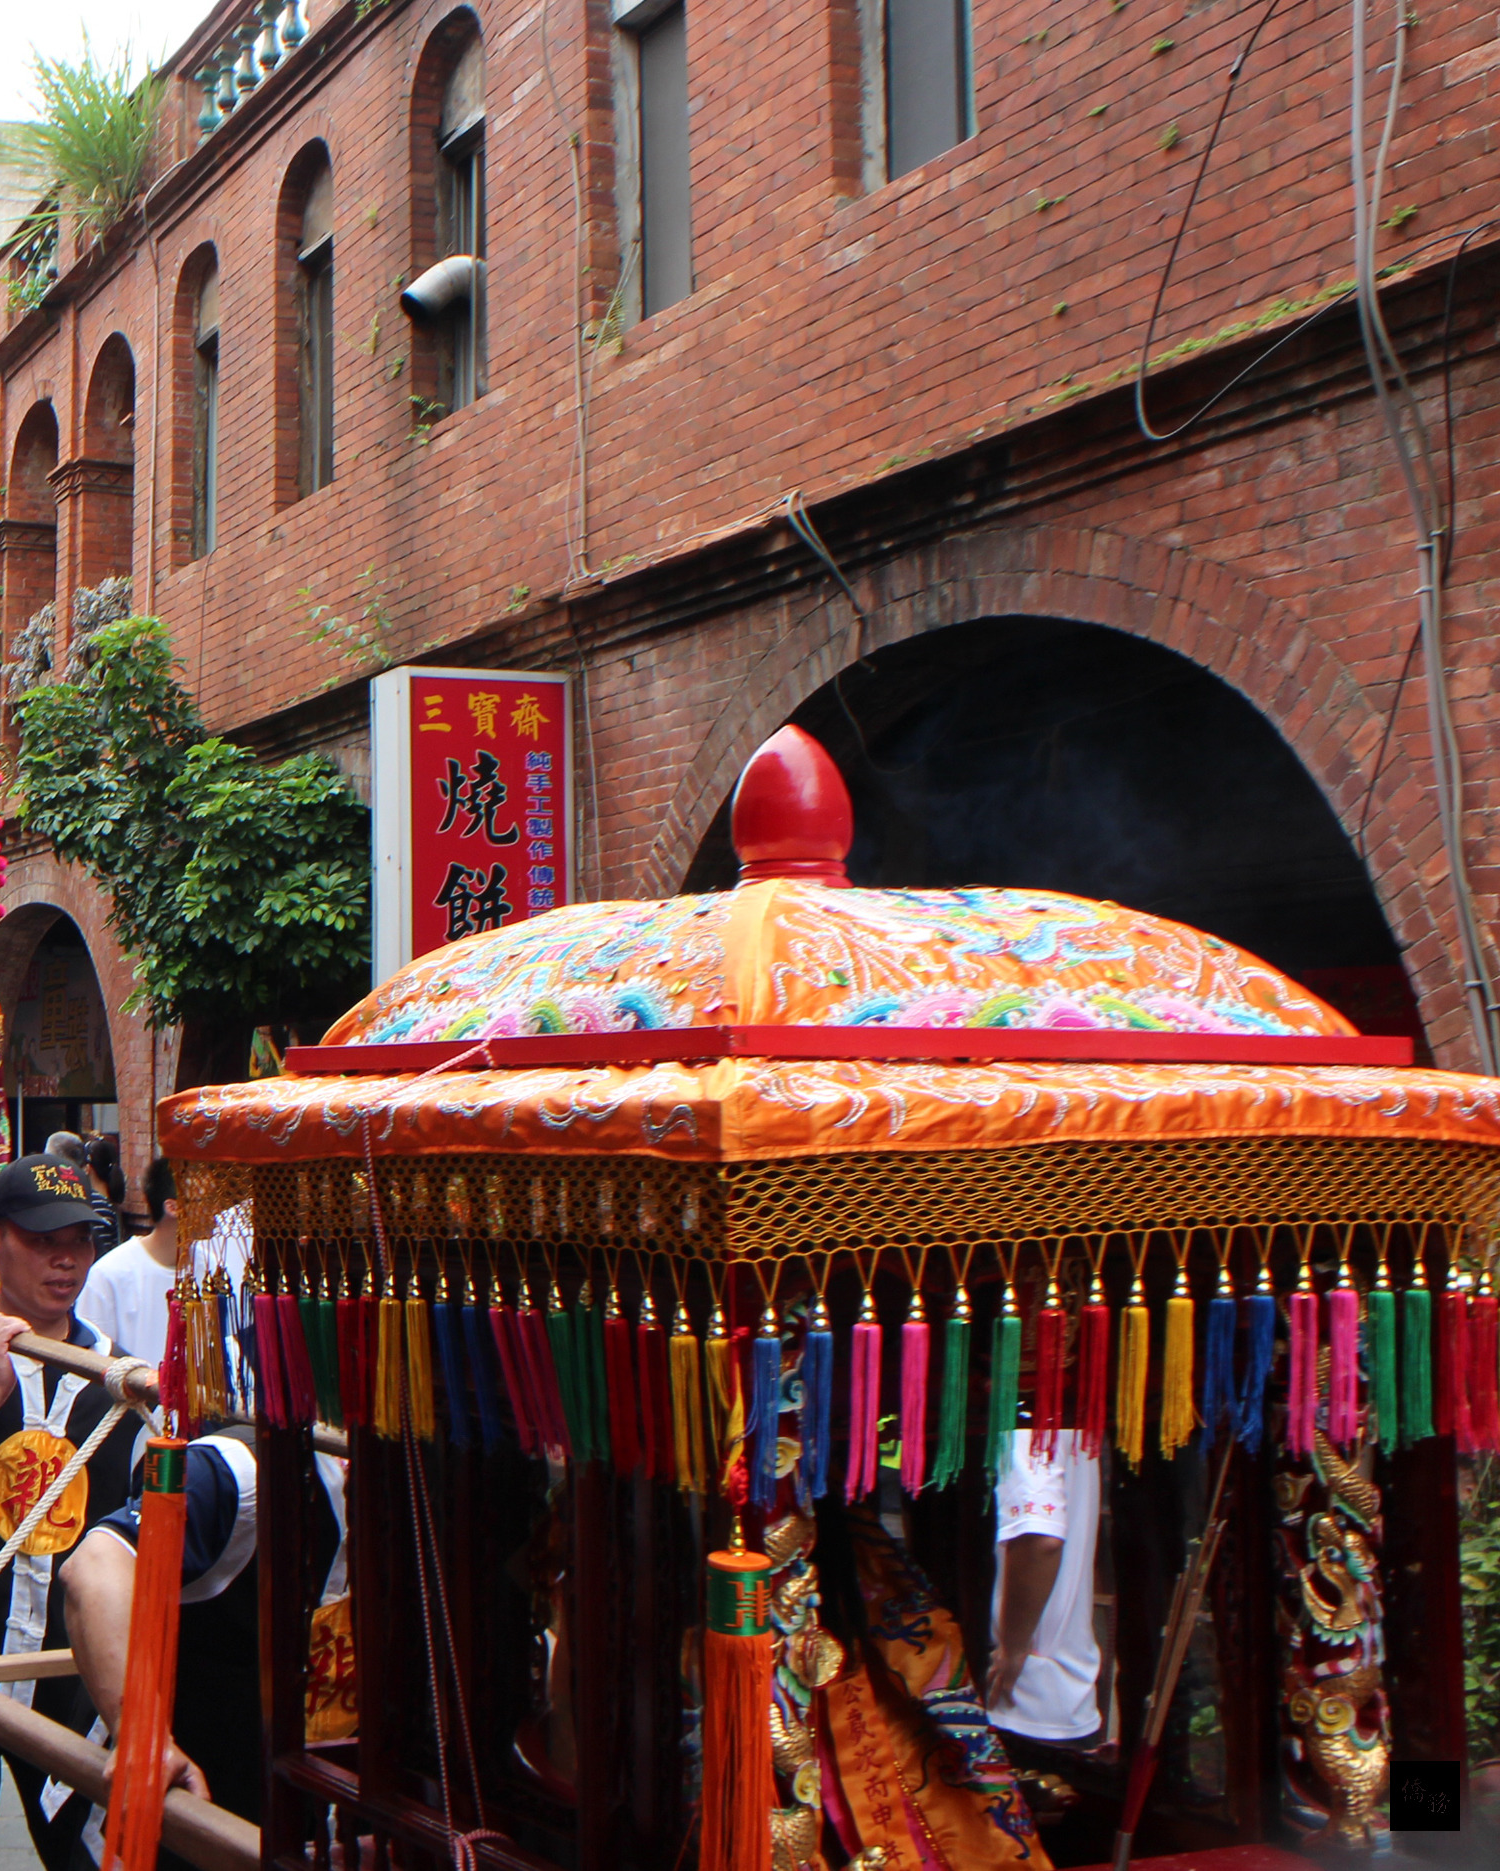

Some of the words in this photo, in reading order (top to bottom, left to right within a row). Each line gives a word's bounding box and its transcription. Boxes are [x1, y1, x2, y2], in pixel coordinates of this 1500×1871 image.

[419, 692, 550, 741] 三寶齋
[432, 749, 520, 942] 燒餅
[525, 751, 555, 917] 純手工製作傳統
